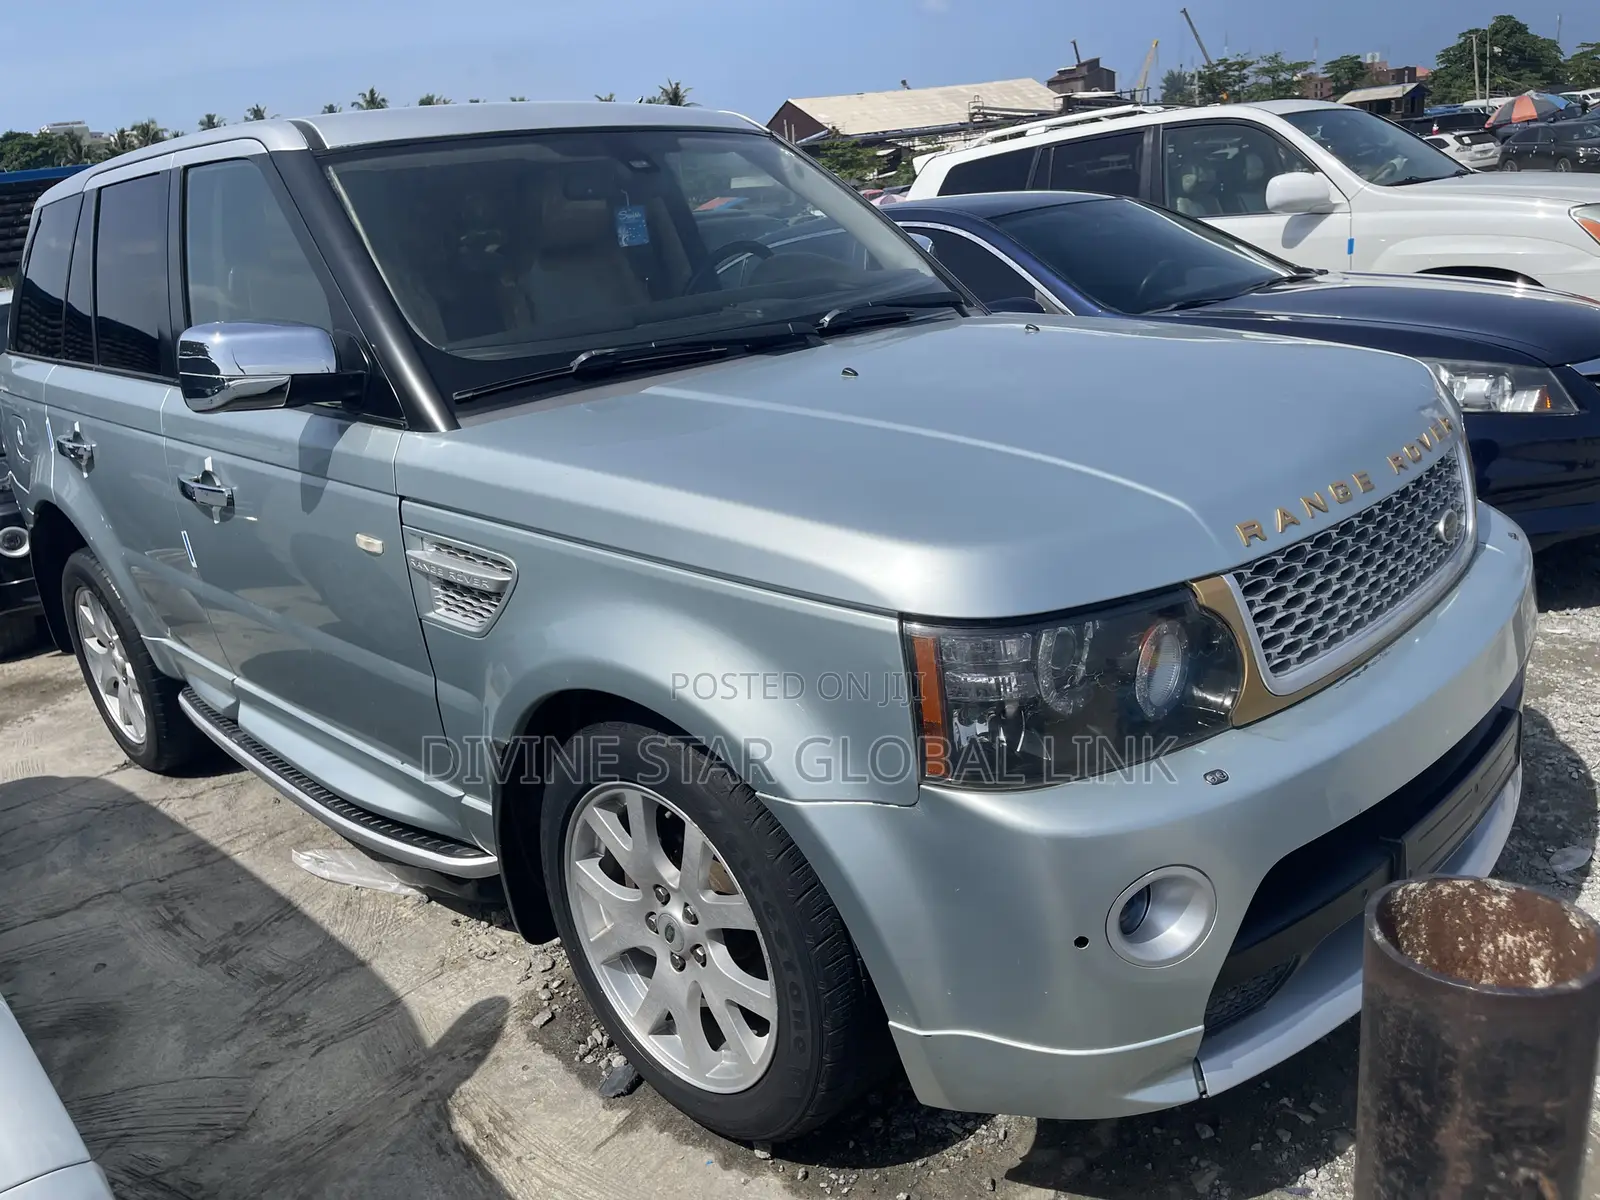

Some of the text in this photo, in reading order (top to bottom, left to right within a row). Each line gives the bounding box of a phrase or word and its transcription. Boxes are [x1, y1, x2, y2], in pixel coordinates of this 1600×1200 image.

[1235, 416, 1453, 547] RANGE ROVER
[448, 571, 490, 589] ROVER
